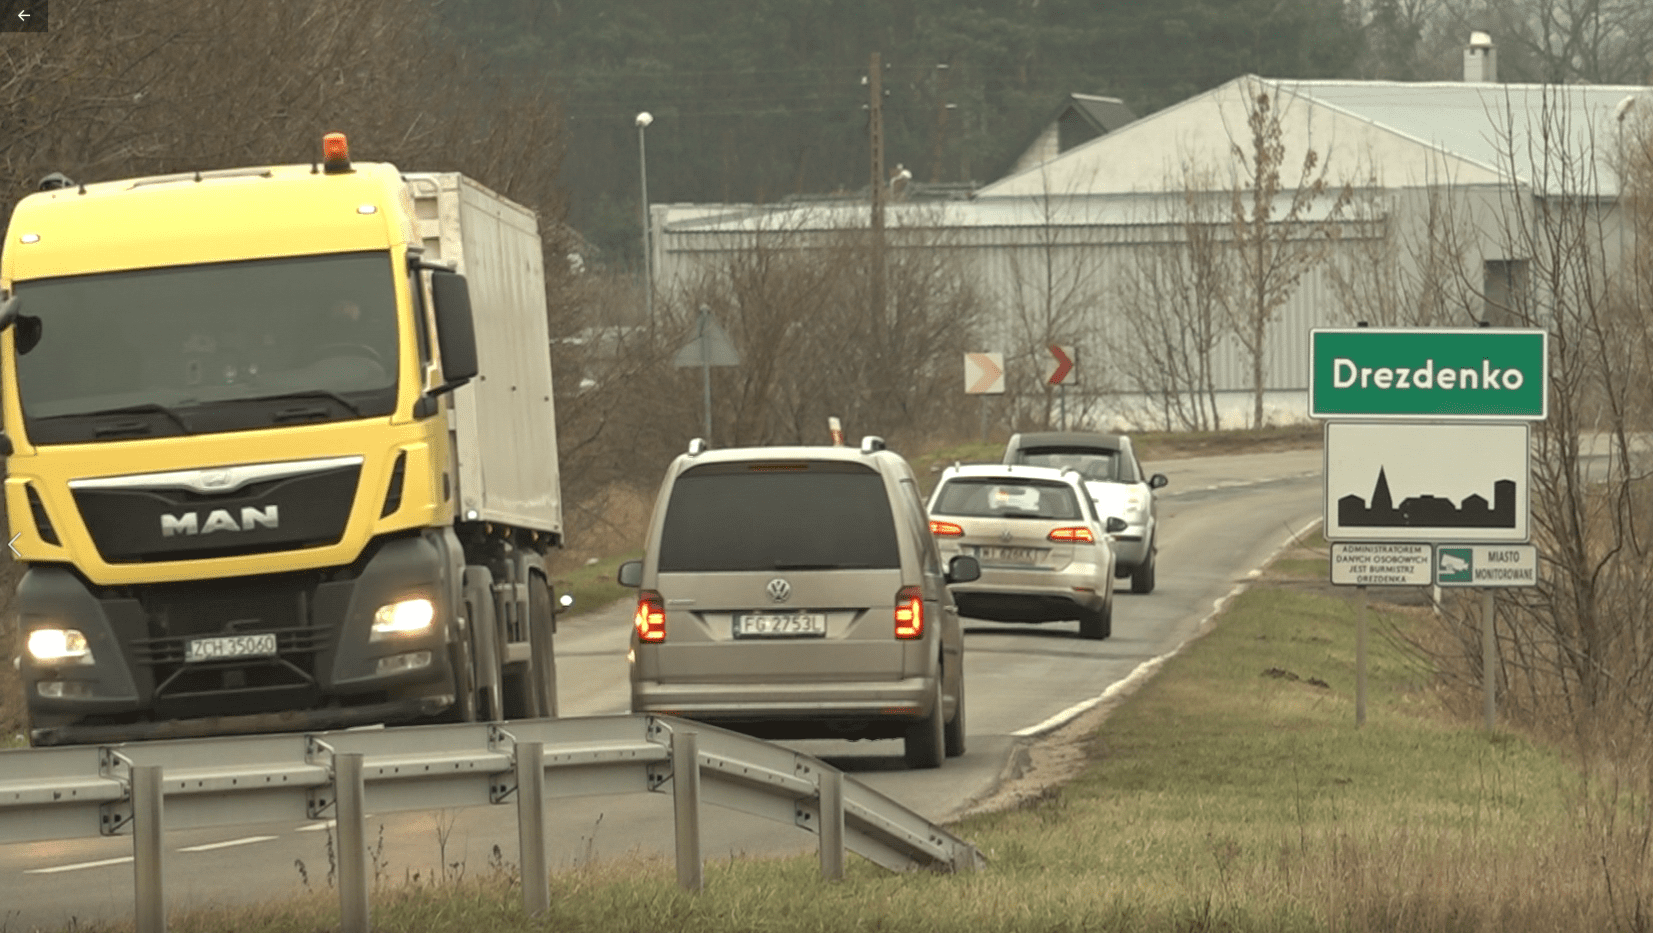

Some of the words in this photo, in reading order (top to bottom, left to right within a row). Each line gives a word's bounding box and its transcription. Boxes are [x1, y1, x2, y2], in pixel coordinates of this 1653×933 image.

[1333, 357, 1524, 390] Drezdenko
[160, 504, 279, 537] MAN
[1342, 545, 1422, 553] ADMINISTRATOREM
[1336, 555, 1371, 563] DANYCH
[1373, 555, 1428, 564] OSOBOWYCH
[1487, 550, 1521, 563] MIASTO
[1349, 565, 1367, 573] JEST
[1369, 565, 1415, 573] BURMISTRZ
[1475, 567, 1533, 580] MONITOROWANE
[744, 615, 767, 632] FG
[771, 615, 823, 632] 2753L
